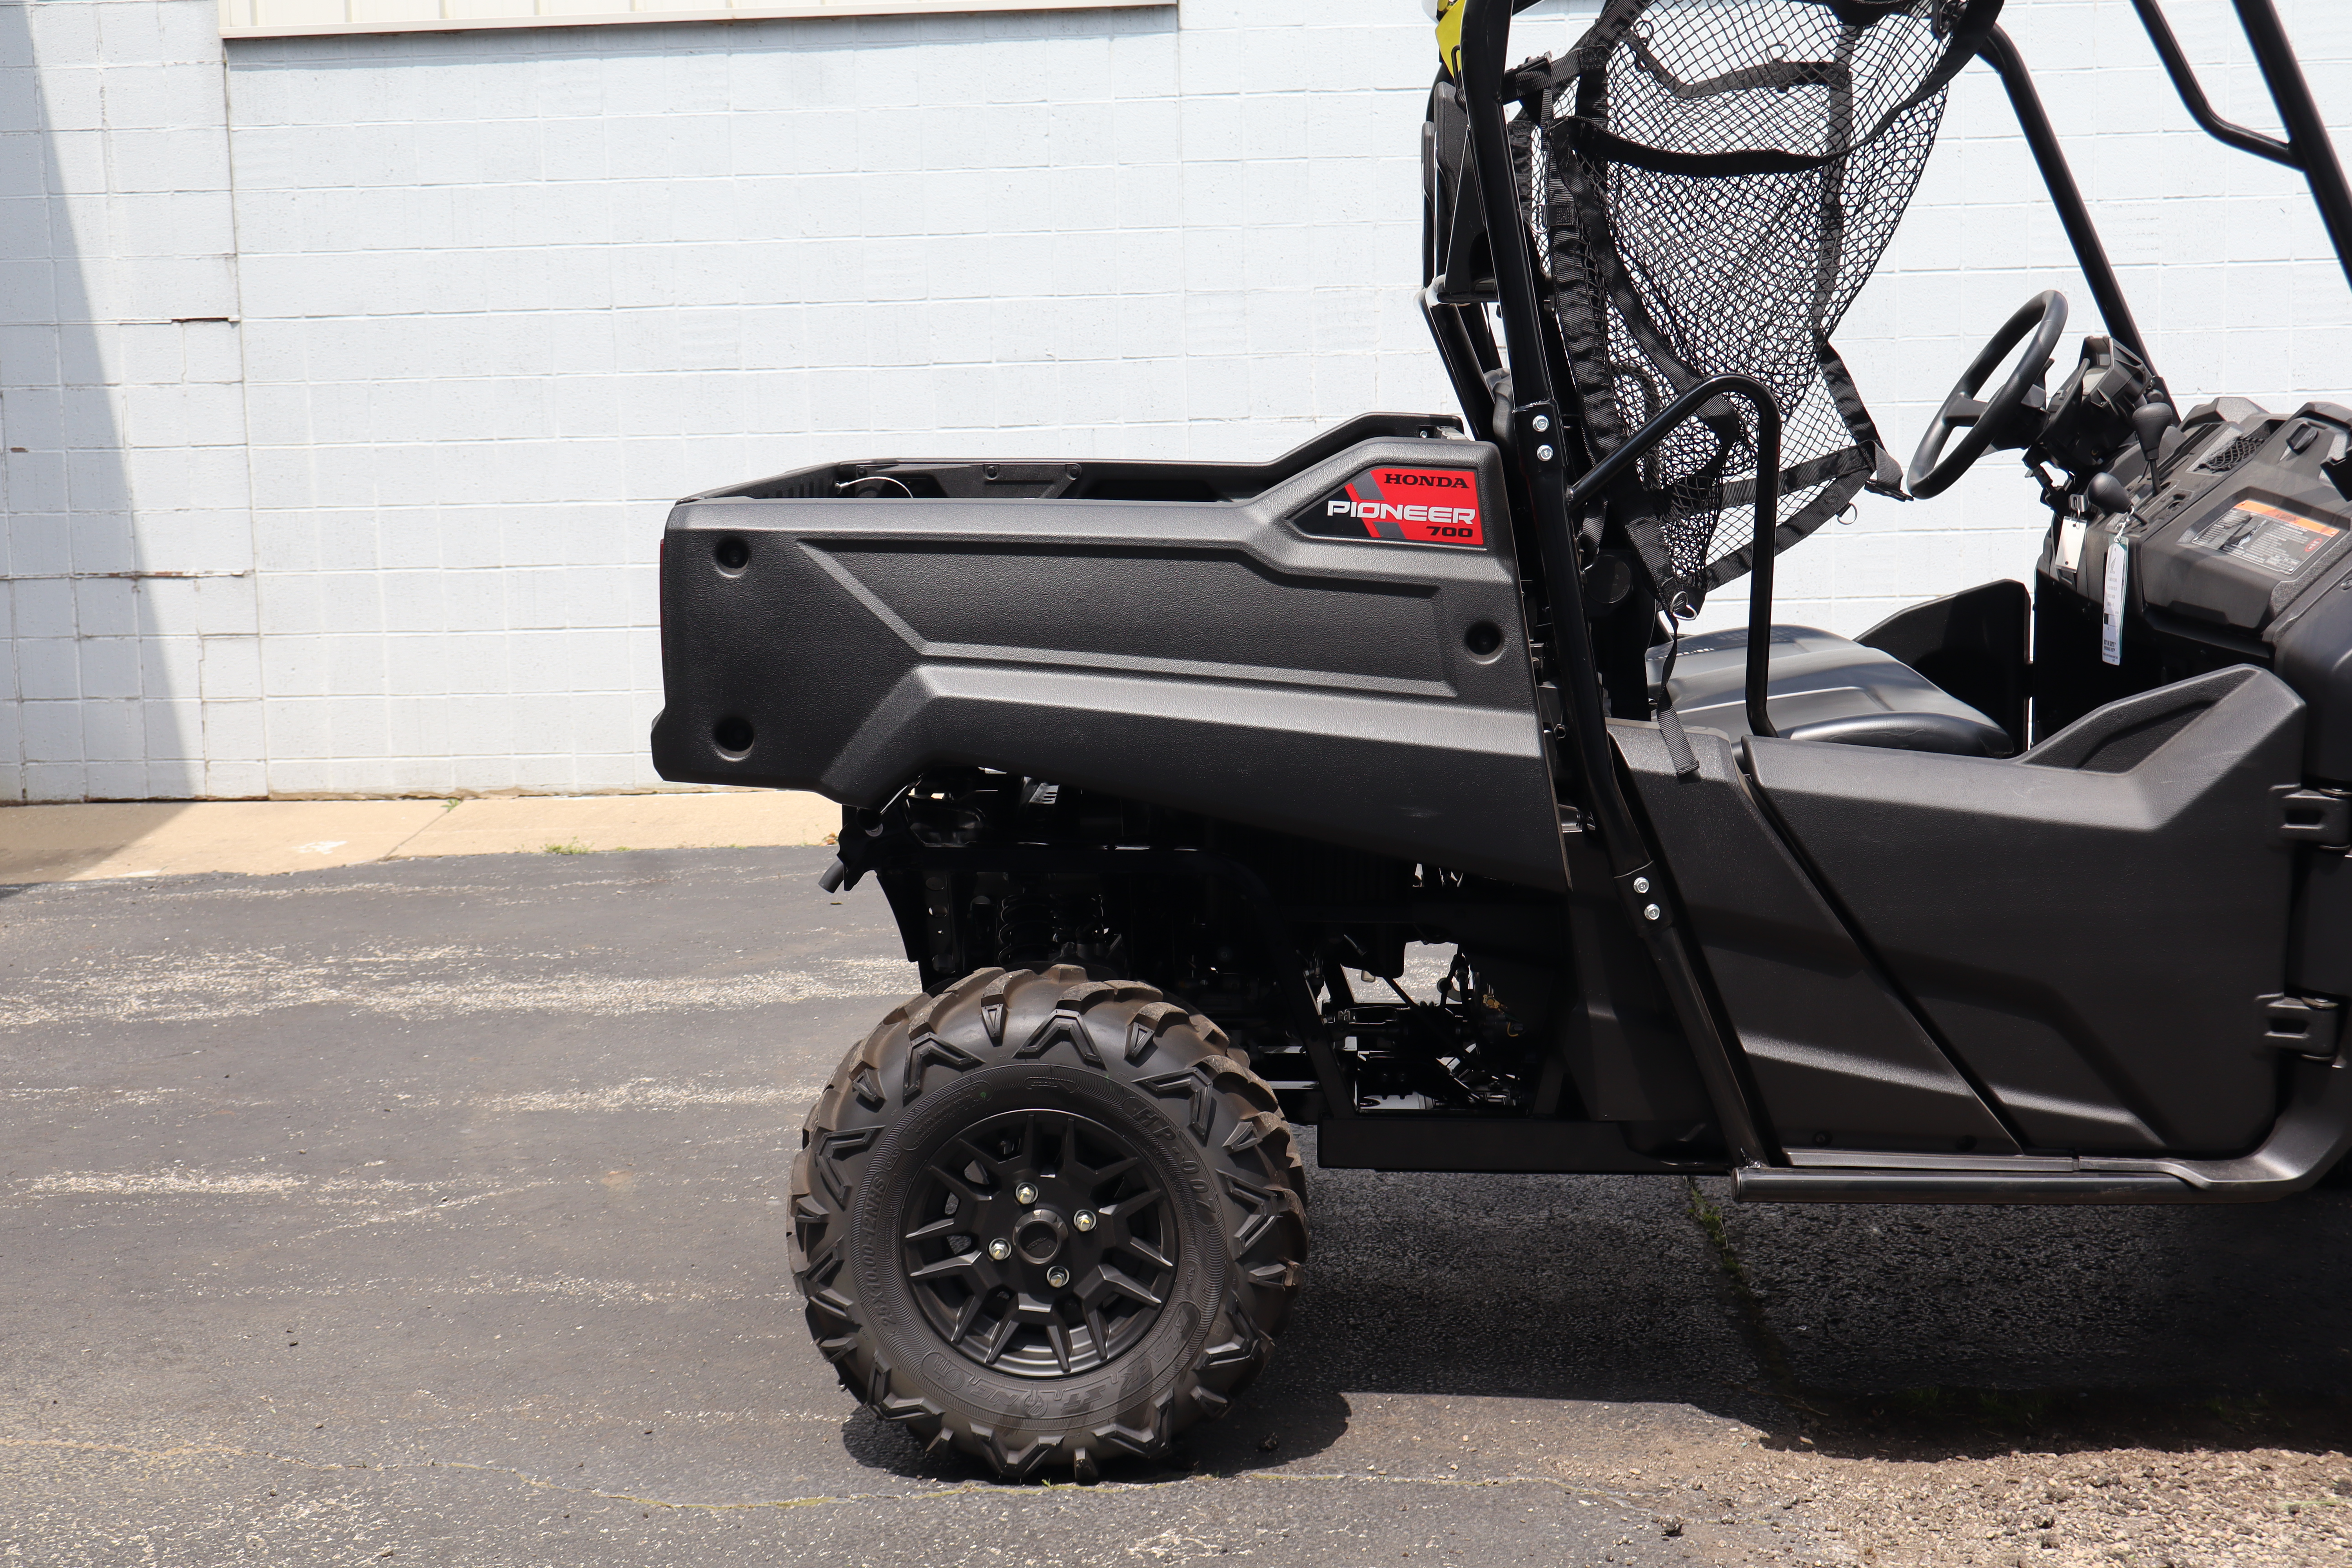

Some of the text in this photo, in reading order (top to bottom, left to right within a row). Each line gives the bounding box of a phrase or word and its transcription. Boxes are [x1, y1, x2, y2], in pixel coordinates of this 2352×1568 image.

[1384, 474, 1469, 489] HONDA
[1327, 500, 1475, 524] PIONEER
[1426, 526, 1473, 537] 700
[938, 1091, 961, 1105] TUBELESS
[1132, 1107, 1216, 1213] HP-007
[862, 1177, 897, 1327] 25X10.00-12NHS
